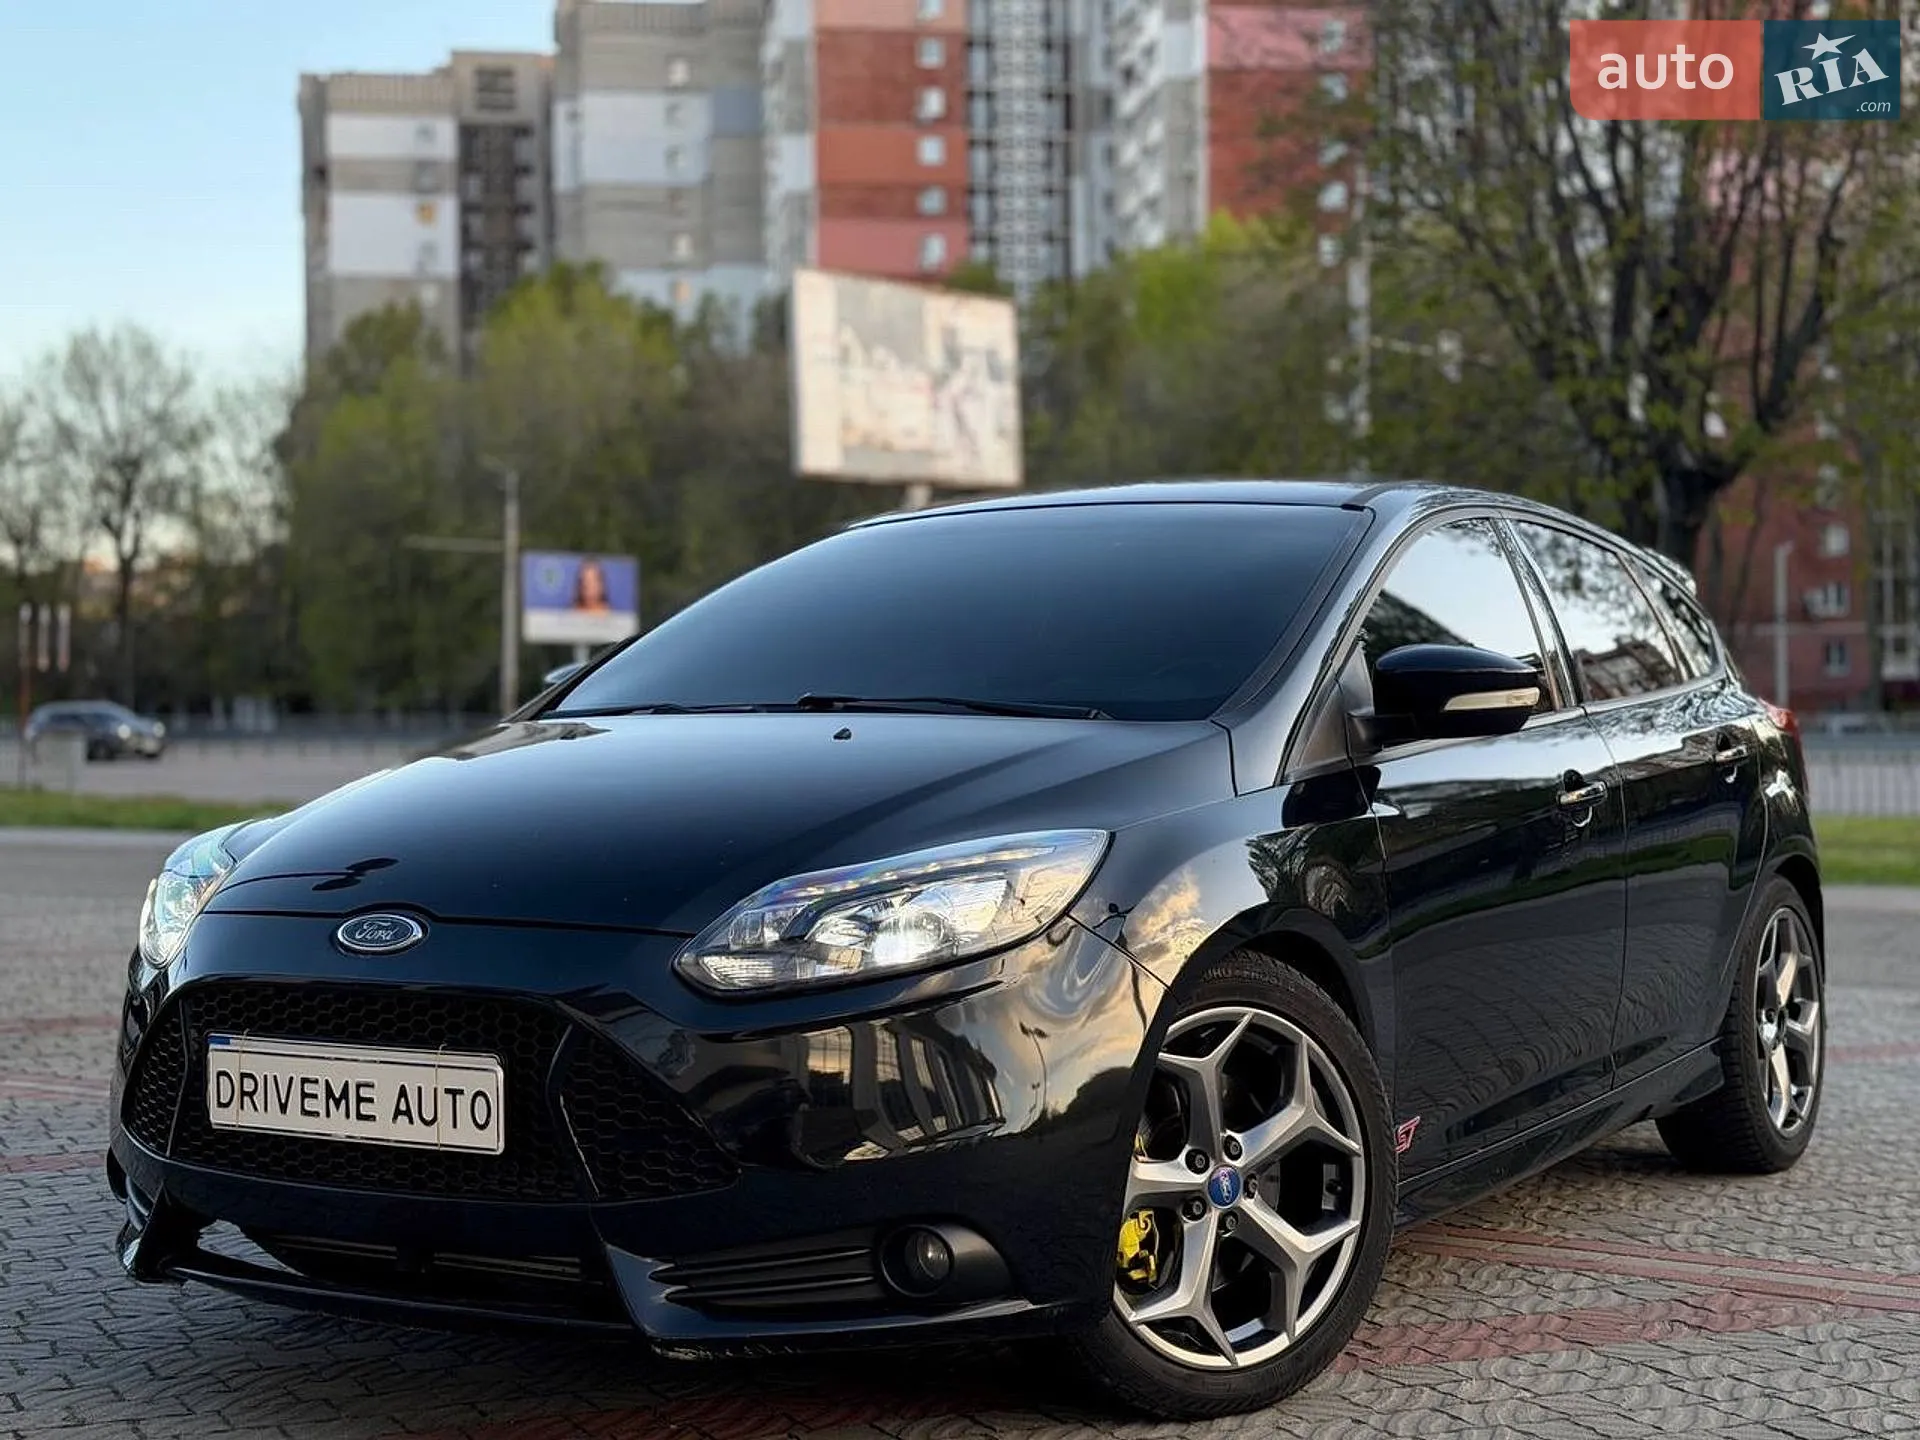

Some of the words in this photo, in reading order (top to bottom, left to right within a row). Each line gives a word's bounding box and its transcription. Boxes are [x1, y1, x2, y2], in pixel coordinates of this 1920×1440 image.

[355, 920, 400, 940] Ford
[216, 1070, 377, 1122] DRIVEME
[392, 1083, 492, 1131] AUTO
